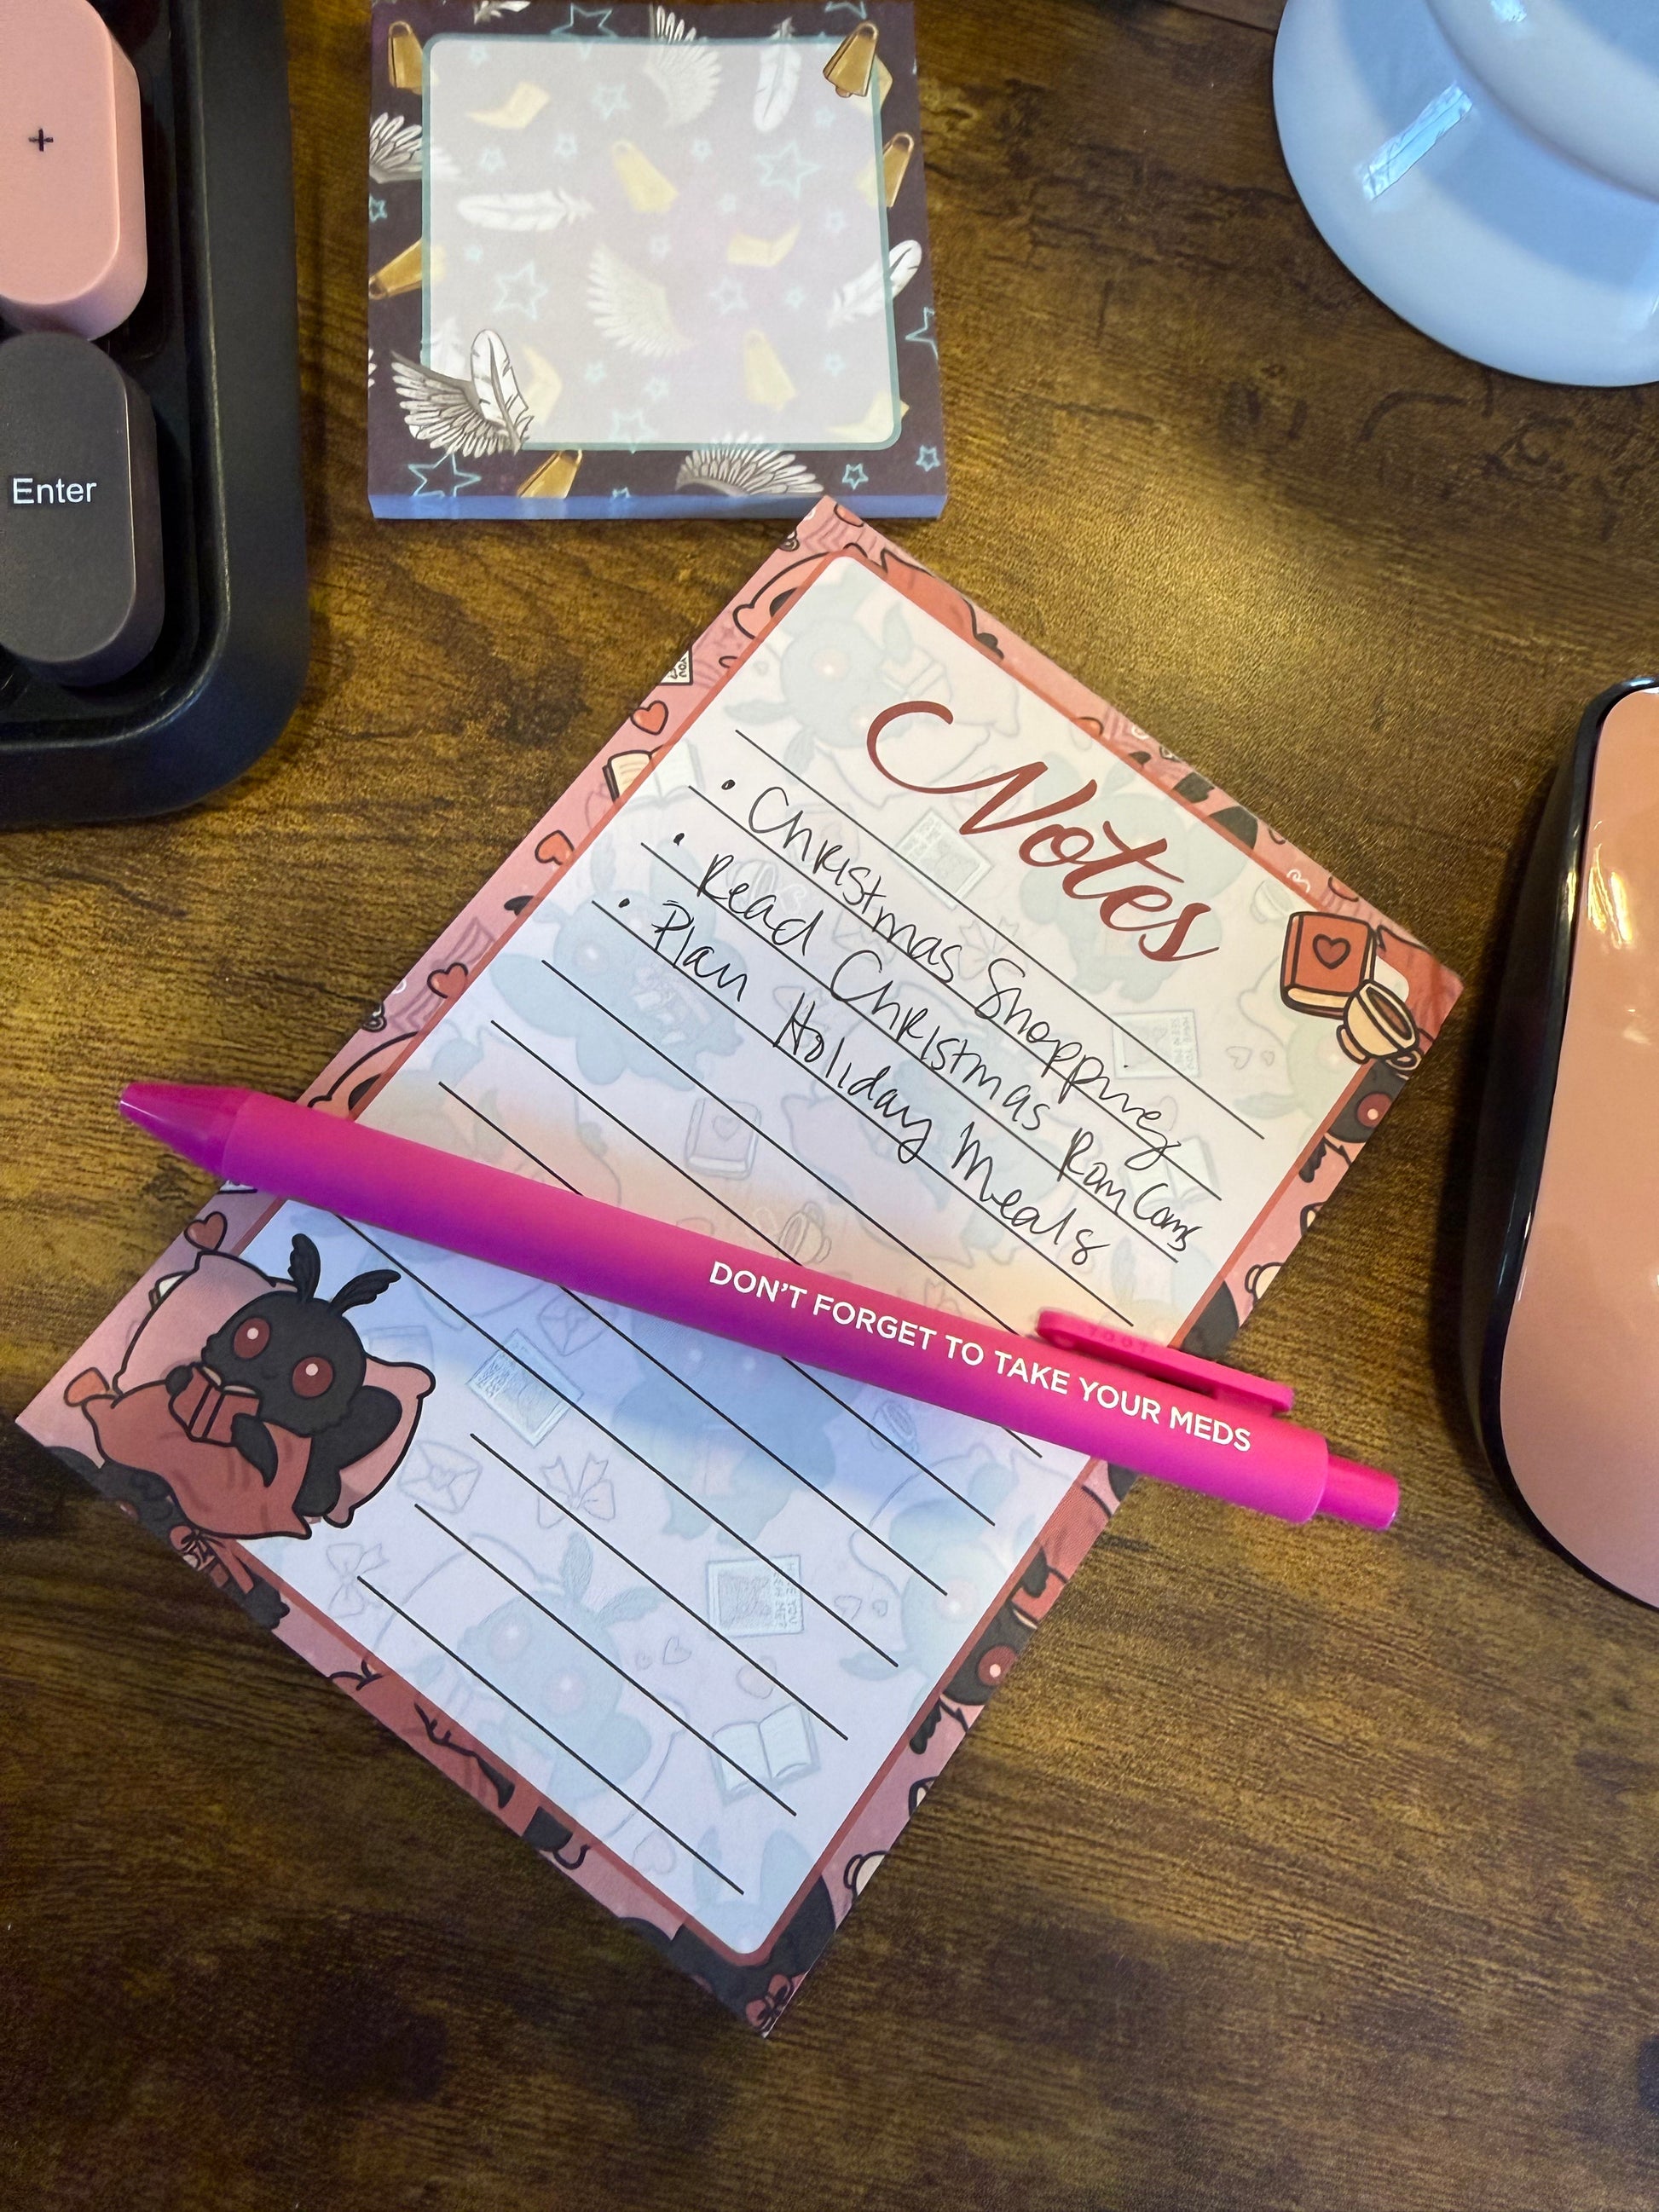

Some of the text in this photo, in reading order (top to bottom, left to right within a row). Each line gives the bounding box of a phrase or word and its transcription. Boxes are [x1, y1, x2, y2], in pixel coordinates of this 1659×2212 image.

[13, 477, 97, 504] Enter
[697, 853, 824, 956] Read
[866, 700, 1220, 962] Notes
[650, 899, 1111, 1266] Plan Holiday Meals
[708, 1260, 1251, 1453] DON'T FORGET TO TAKE YOUR MEDS
